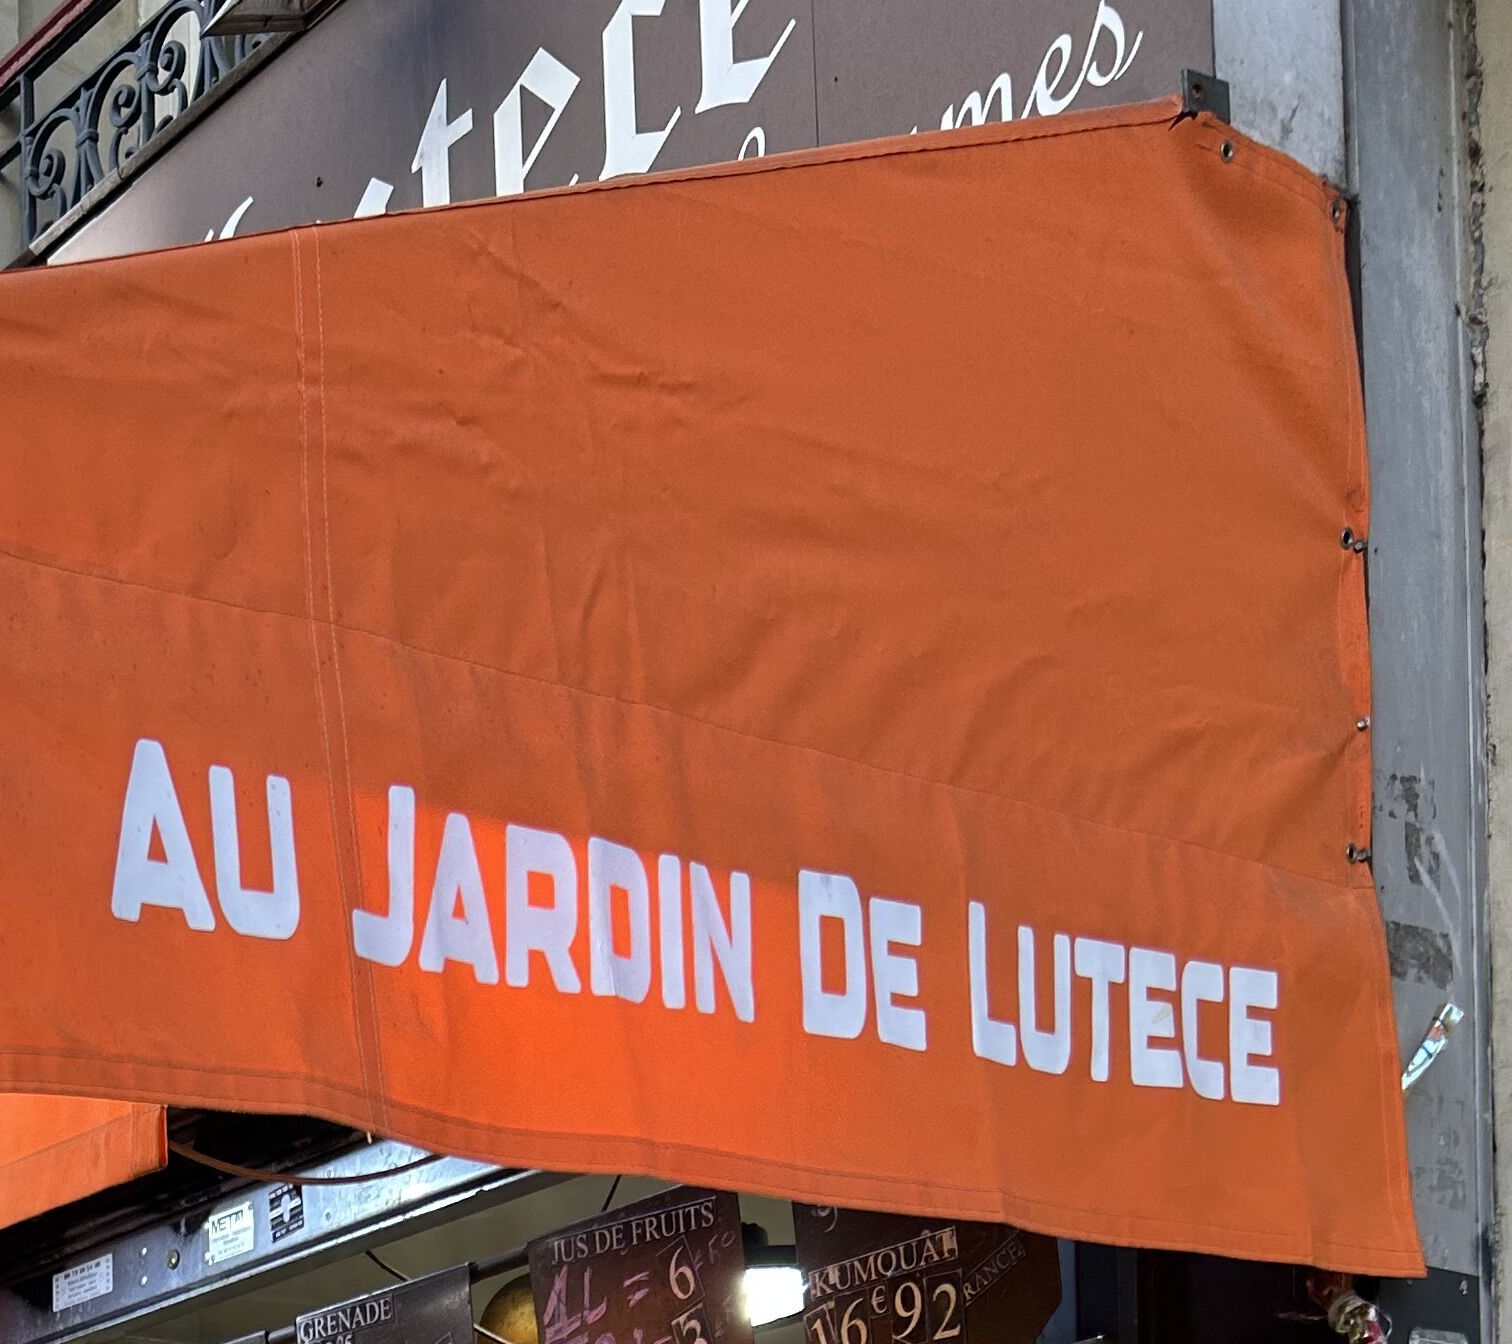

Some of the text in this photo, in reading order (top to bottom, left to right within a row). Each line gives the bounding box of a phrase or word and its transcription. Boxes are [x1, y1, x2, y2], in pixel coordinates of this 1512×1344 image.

[111, 736, 1280, 1106] AU JARDIN DE LUTECE
[550, 1201, 716, 1265] JUS DE FRUITS
[299, 1297, 393, 1344] GRENADE
